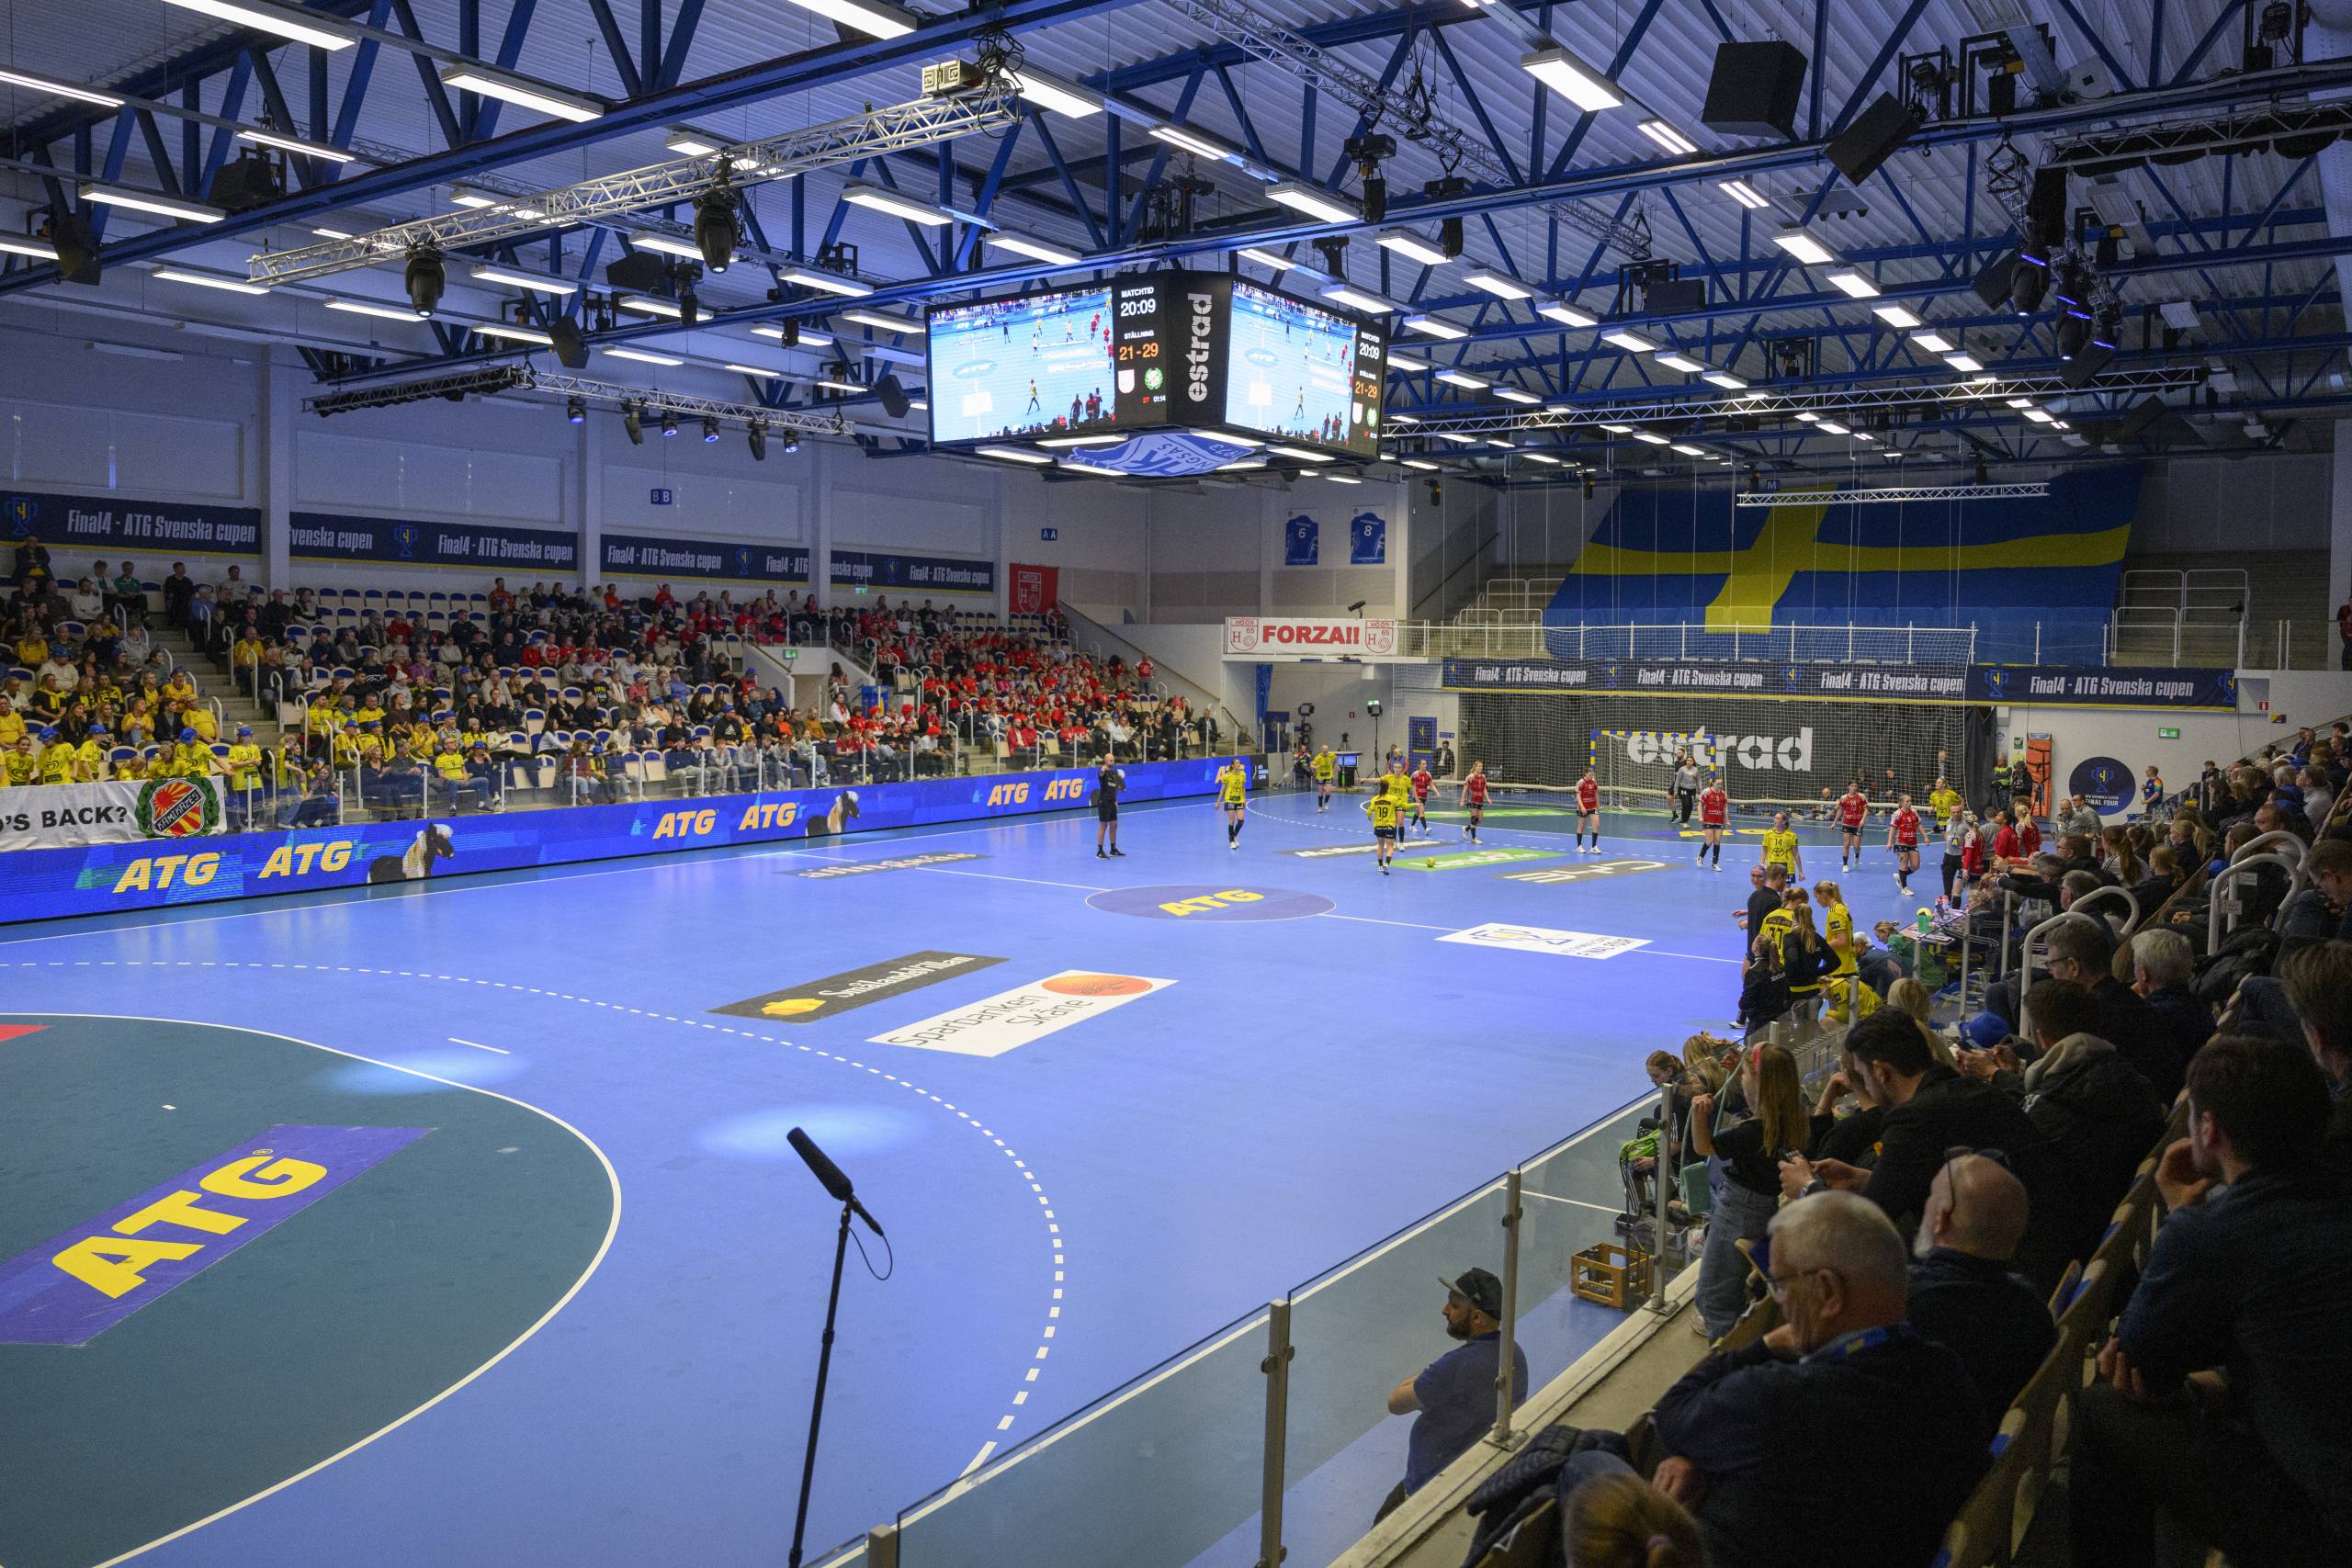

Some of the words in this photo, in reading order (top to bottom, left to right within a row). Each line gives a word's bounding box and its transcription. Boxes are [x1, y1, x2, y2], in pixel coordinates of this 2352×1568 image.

[1121, 287, 1154, 298] MATCHTID
[1120, 299, 1157, 317] 20:09
[1124, 330, 1155, 340] STÄLLNING
[1185, 292, 1213, 402] estrad
[1360, 342, 1379, 360] 20:09
[662, 491, 670, 502] B
[67, 509, 112, 534] Final4
[124, 513, 151, 537] ATG
[154, 515, 212, 540] Svenska
[216, 524, 255, 546] cupen
[1051, 530, 1057, 539] A
[1298, 527, 1306, 538] 6
[1363, 525, 1373, 536] 8
[337, 530, 373, 552] cupen
[438, 534, 470, 555] Final4
[478, 537, 498, 558] ATG
[500, 539, 542, 559] Svenska
[544, 545, 573, 563] cupen
[607, 545, 635, 565] Final4
[641, 547, 659, 565] ATG
[660, 549, 695, 569] Svenska
[696, 555, 722, 571] cupen
[766, 555, 788, 572] Final4
[794, 558, 809, 574] ATG
[853, 563, 873, 579] cupen
[910, 565, 928, 581] Final4
[933, 568, 945, 582] ATG
[946, 568, 971, 584] Svenska
[972, 572, 989, 587] cupen
[1232, 631, 1240, 643] H
[1262, 625, 1360, 645] FORZA!!
[1368, 634, 1375, 645] H
[1475, 666, 1499, 682] Final4
[1505, 667, 1522, 682] ATG
[1523, 667, 1559, 682] Svenska
[1560, 670, 1587, 685] cupen
[1637, 669, 1665, 684] Final4
[1672, 669, 1690, 684] ATG
[1691, 670, 1731, 686] Svenska
[1733, 672, 1763, 689] cupen
[1821, 671, 1851, 688] Final4
[1860, 672, 1879, 689] ATG
[1883, 673, 1928, 691] Svenska
[1930, 677, 1963, 694] cupen
[2030, 676, 2065, 694] Final4
[2075, 677, 2097, 694] ATG
[2100, 677, 2152, 695] Svenska
[2155, 682, 2194, 700] cupen
[1627, 725, 1813, 772] estrad
[987, 783, 1029, 807] ATG
[1044, 778, 1083, 801] ATG
[41, 806, 128, 829] BACK?
[155, 787, 202, 833] KAMIKAZES
[738, 802, 797, 830] ATG
[652, 808, 717, 839] ATG
[1775, 838, 1782, 846] 14
[257, 840, 353, 879] ATG
[112, 852, 220, 894] ATG
[1158, 889, 1265, 916] ATG
[819, 955, 976, 998] SmålandsVillan
[887, 993, 1048, 1047] Sparbanken
[1005, 998, 1095, 1028] Skåne
[51, 1156, 328, 1300] ATG
